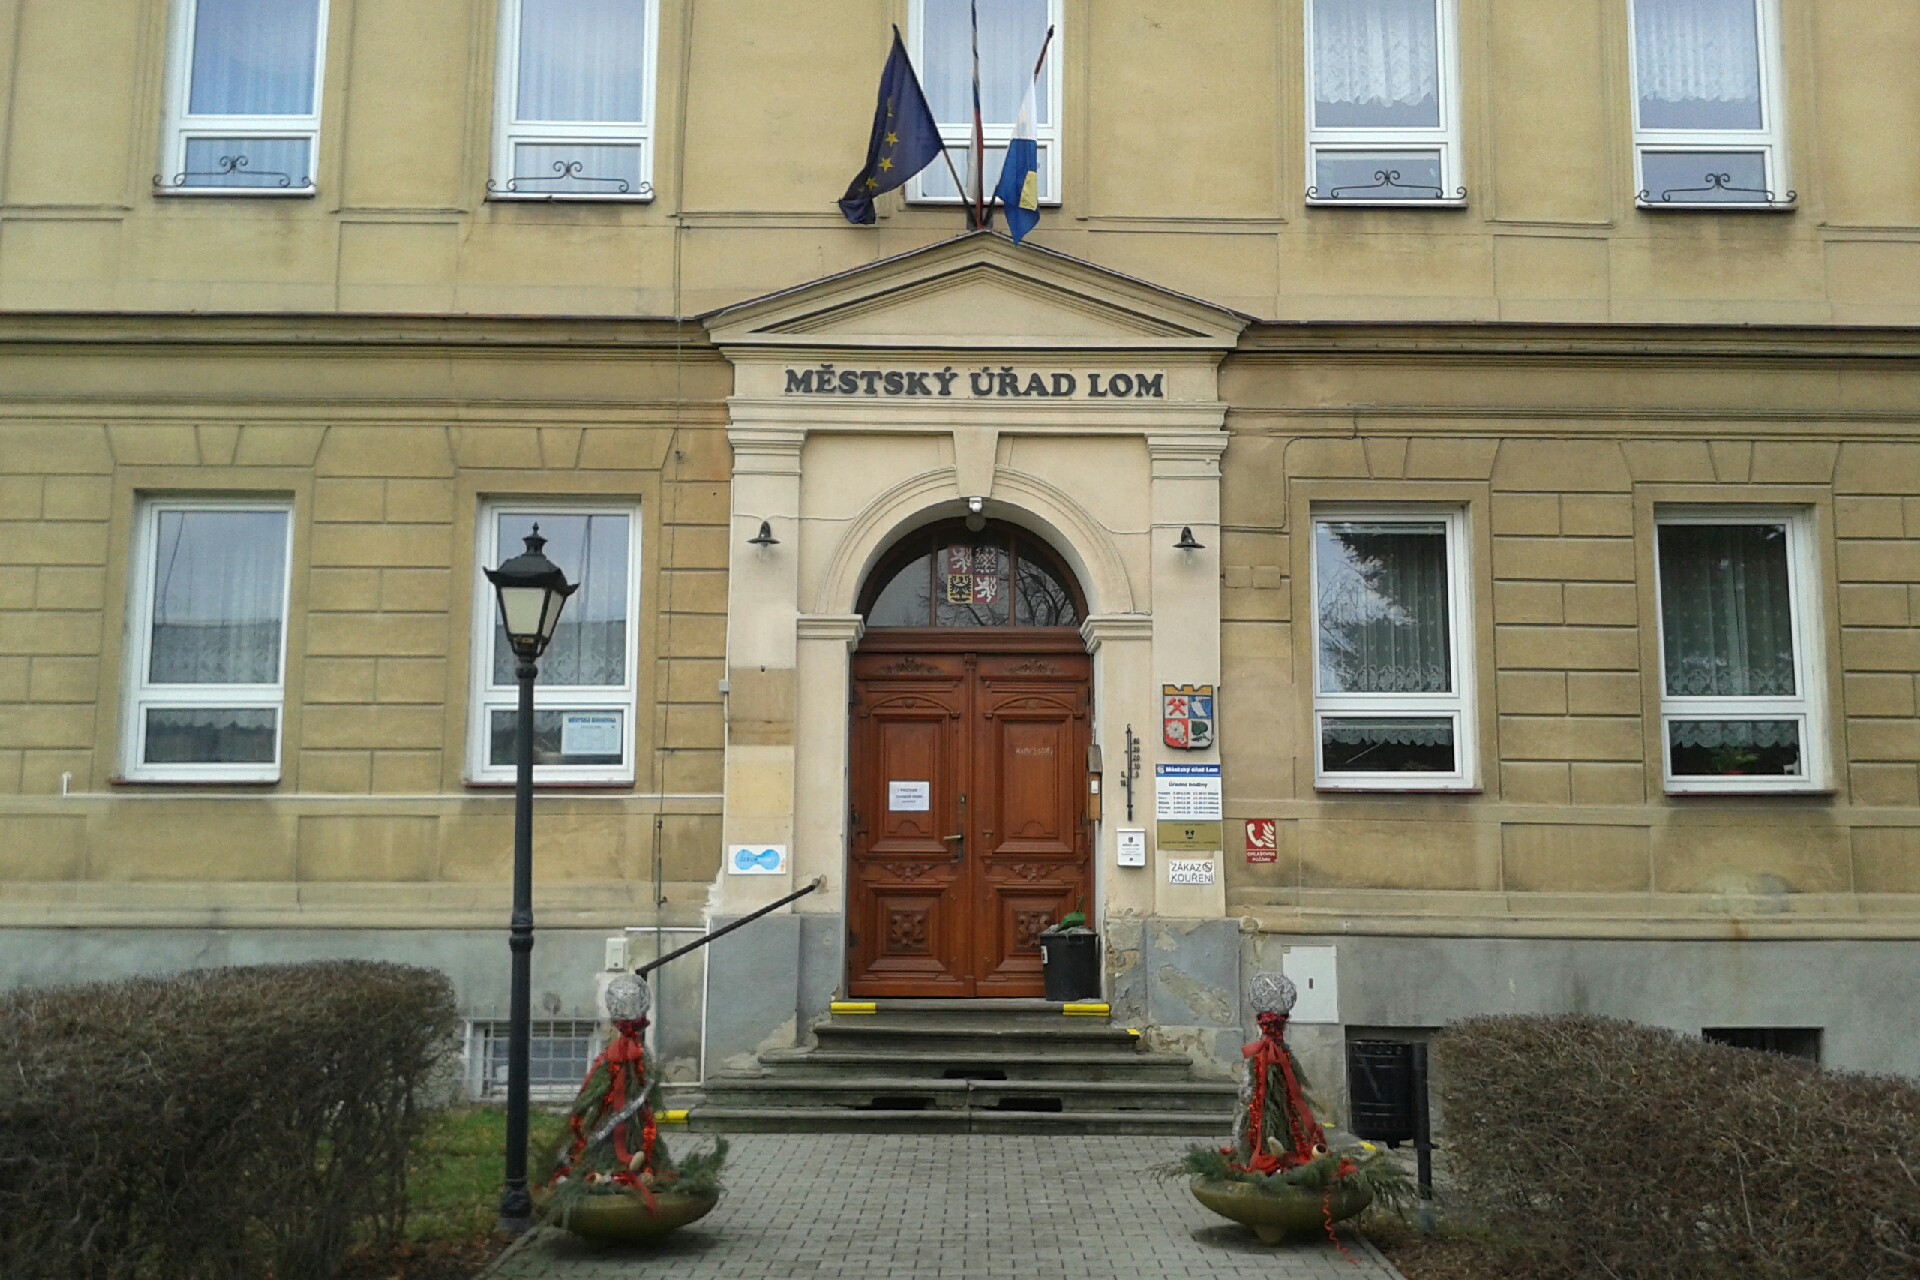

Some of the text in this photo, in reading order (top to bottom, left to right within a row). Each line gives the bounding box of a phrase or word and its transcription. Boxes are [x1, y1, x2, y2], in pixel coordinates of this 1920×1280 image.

[785, 364, 1164, 397] MĚSTSKÝ ÚŘAD LOM
[1172, 861, 1202, 872] ZÁKAZ
[1172, 872, 1214, 883] KOUŘENÍ
